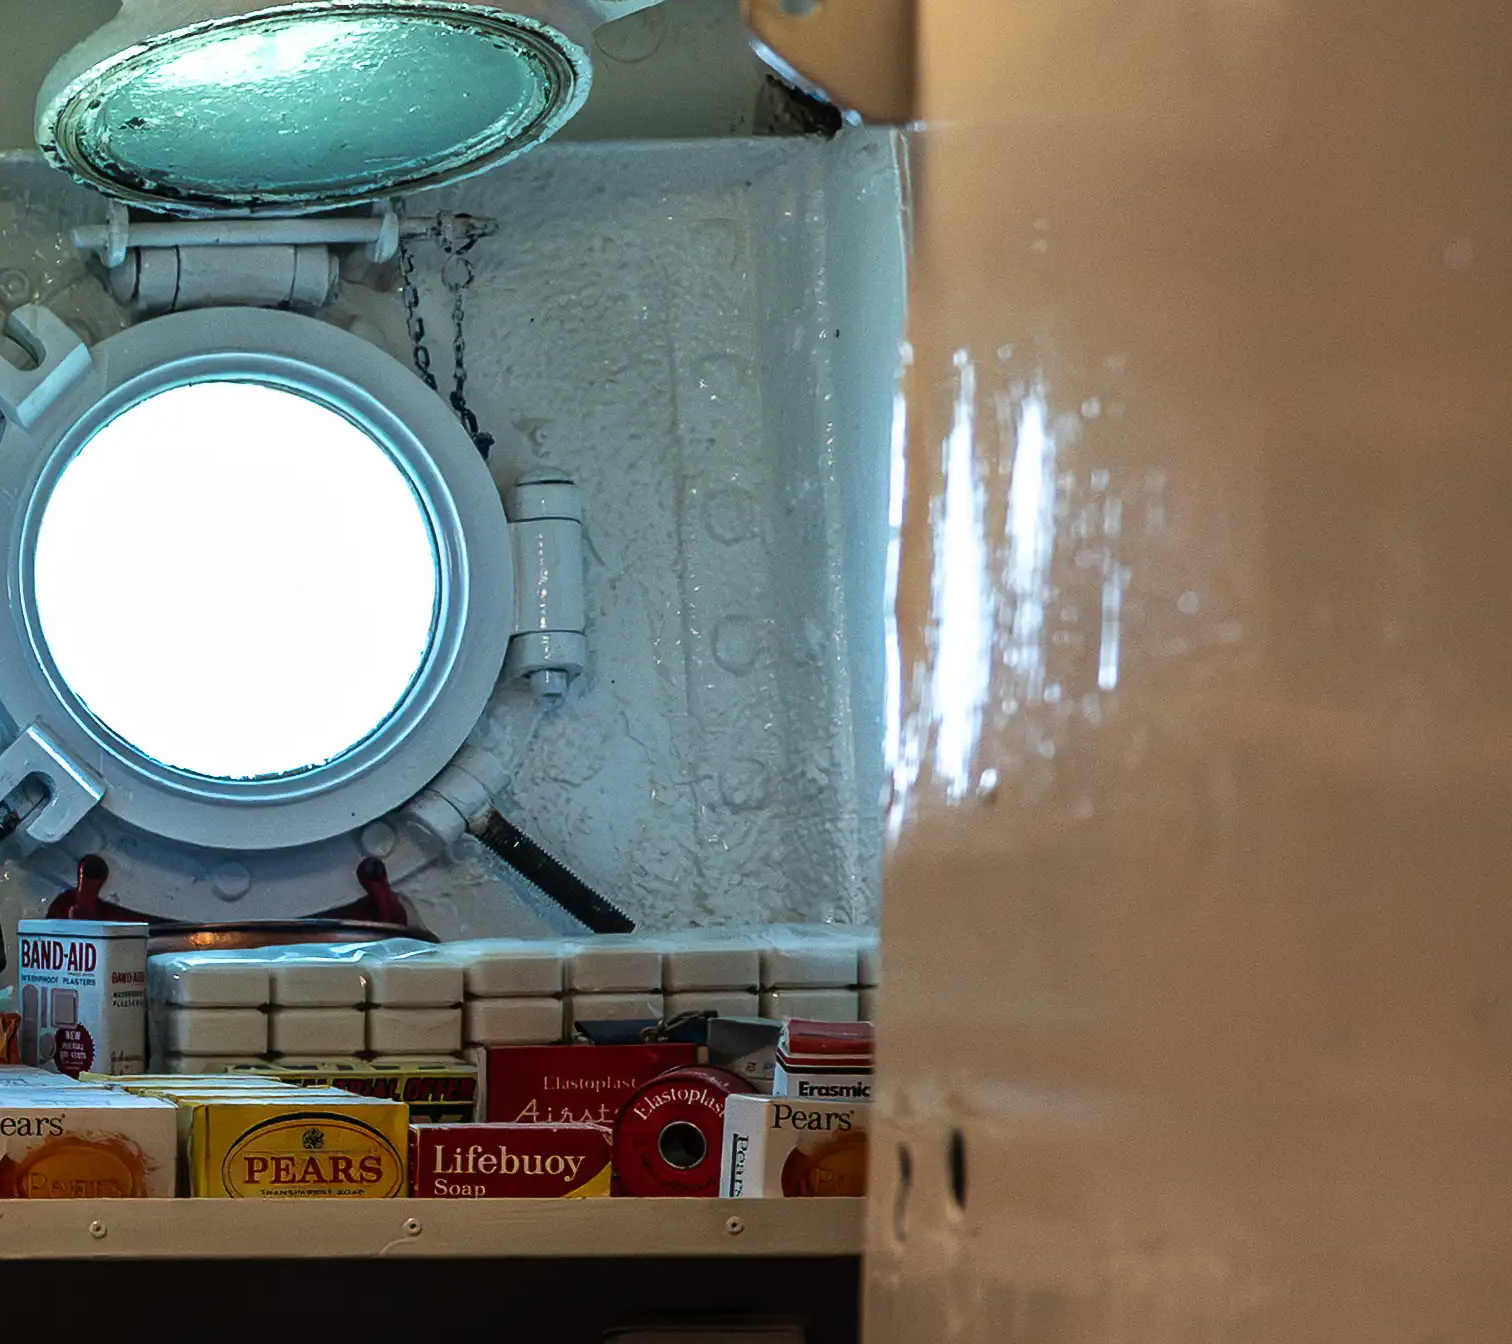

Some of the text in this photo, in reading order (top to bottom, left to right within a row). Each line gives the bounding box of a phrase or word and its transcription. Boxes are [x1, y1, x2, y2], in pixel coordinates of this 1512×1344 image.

[242, 1153, 384, 1186] PEARS
[431, 1145, 586, 1182] Lifebuoy
[432, 1179, 486, 1201] Soap
